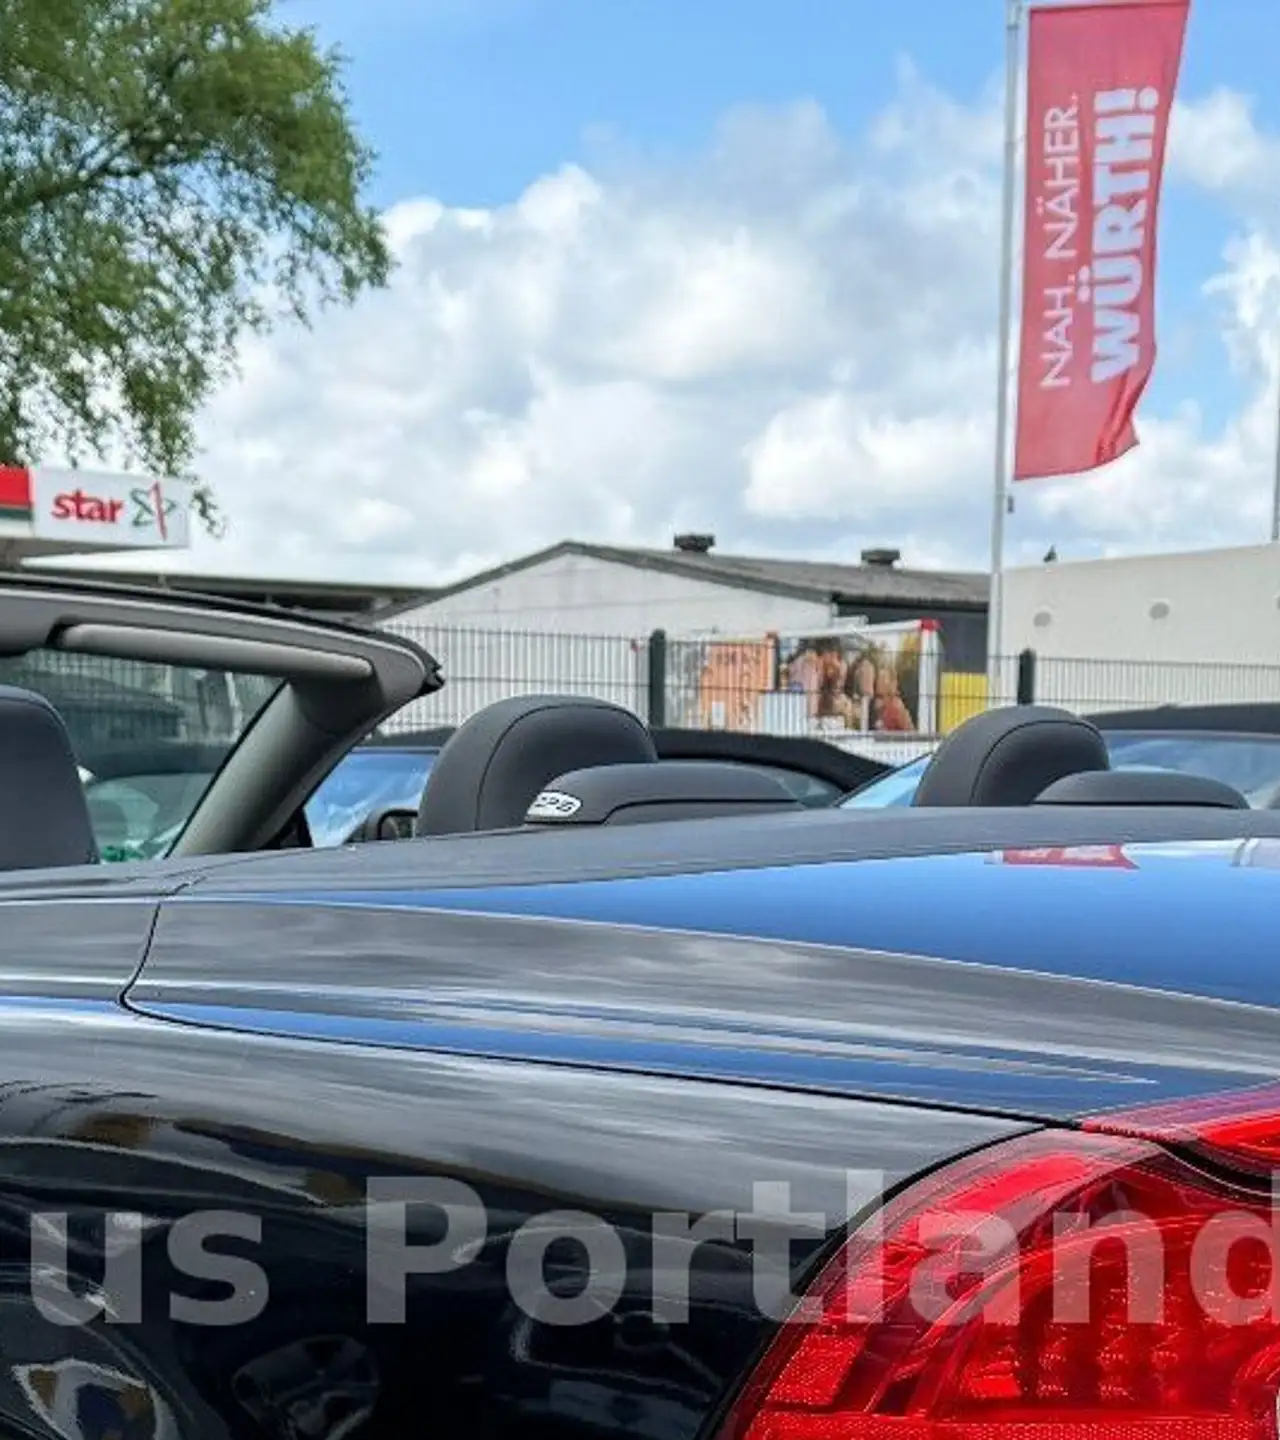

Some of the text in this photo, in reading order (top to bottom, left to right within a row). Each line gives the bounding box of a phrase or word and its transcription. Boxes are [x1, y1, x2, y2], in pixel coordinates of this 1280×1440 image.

[1035, 91, 1080, 390] NAH. NÄHER.
[1077, 86, 1160, 384] WÜRTH!
[51, 488, 124, 524] star
